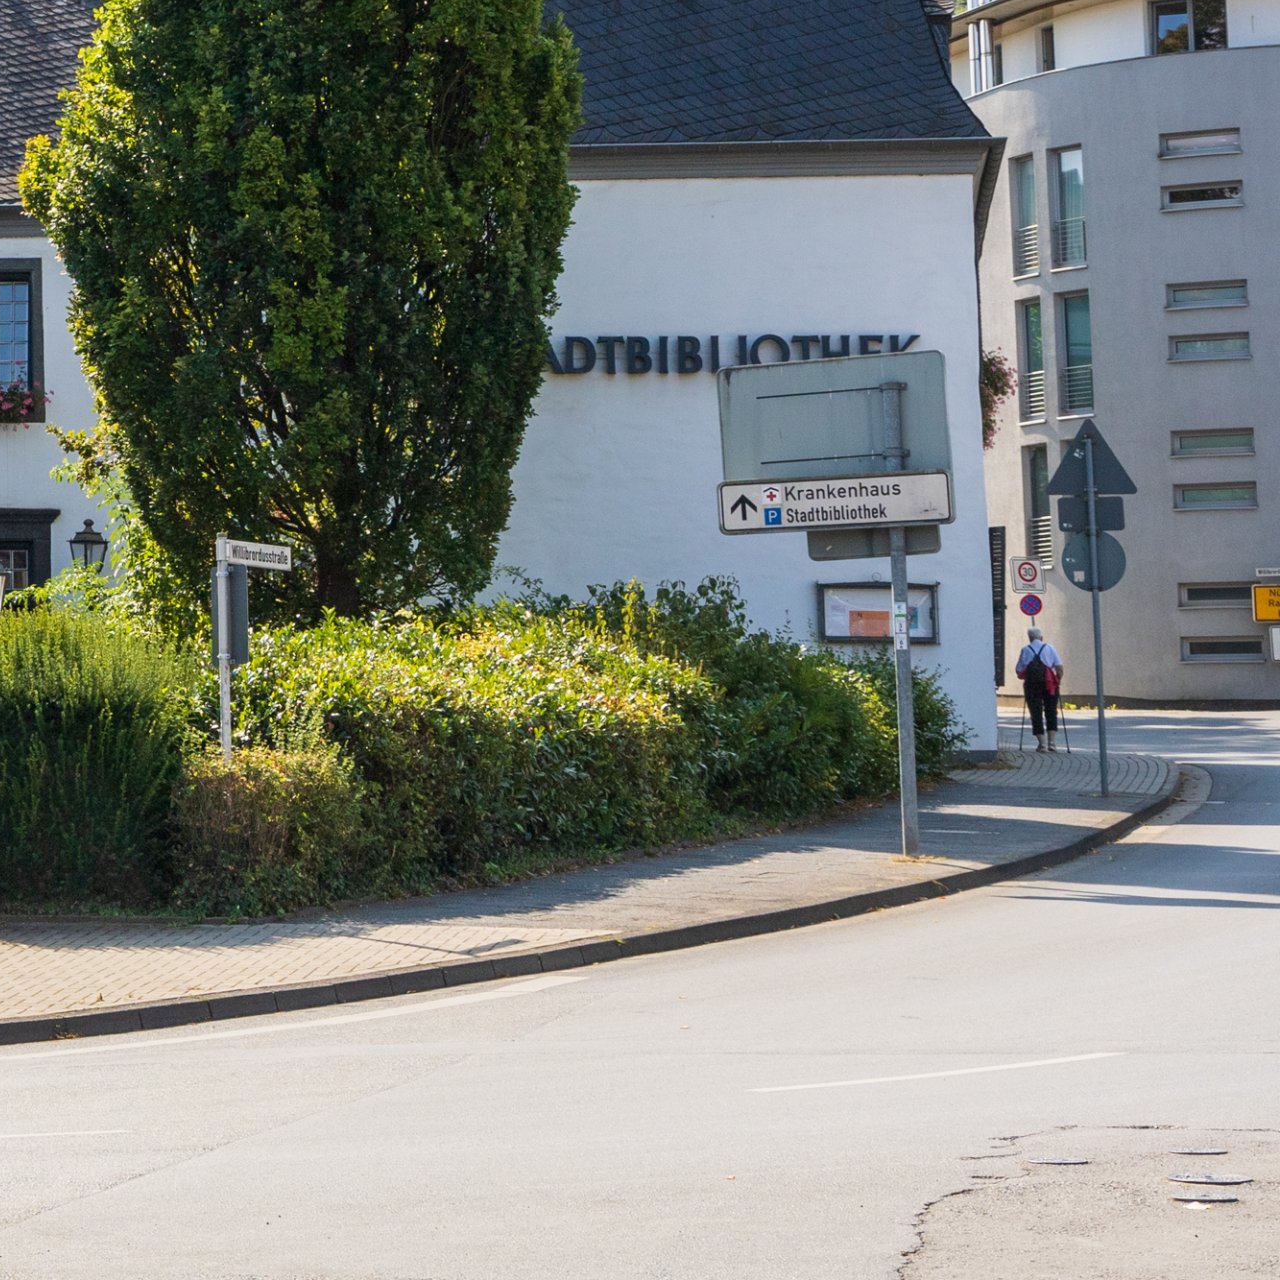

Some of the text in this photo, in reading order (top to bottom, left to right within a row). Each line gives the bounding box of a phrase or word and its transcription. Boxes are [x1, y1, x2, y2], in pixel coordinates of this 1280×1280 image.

[784, 482, 901, 501] Krankenhaus
[786, 504, 888, 523] Stadtbibliothek
[1022, 567, 1034, 577] 30
